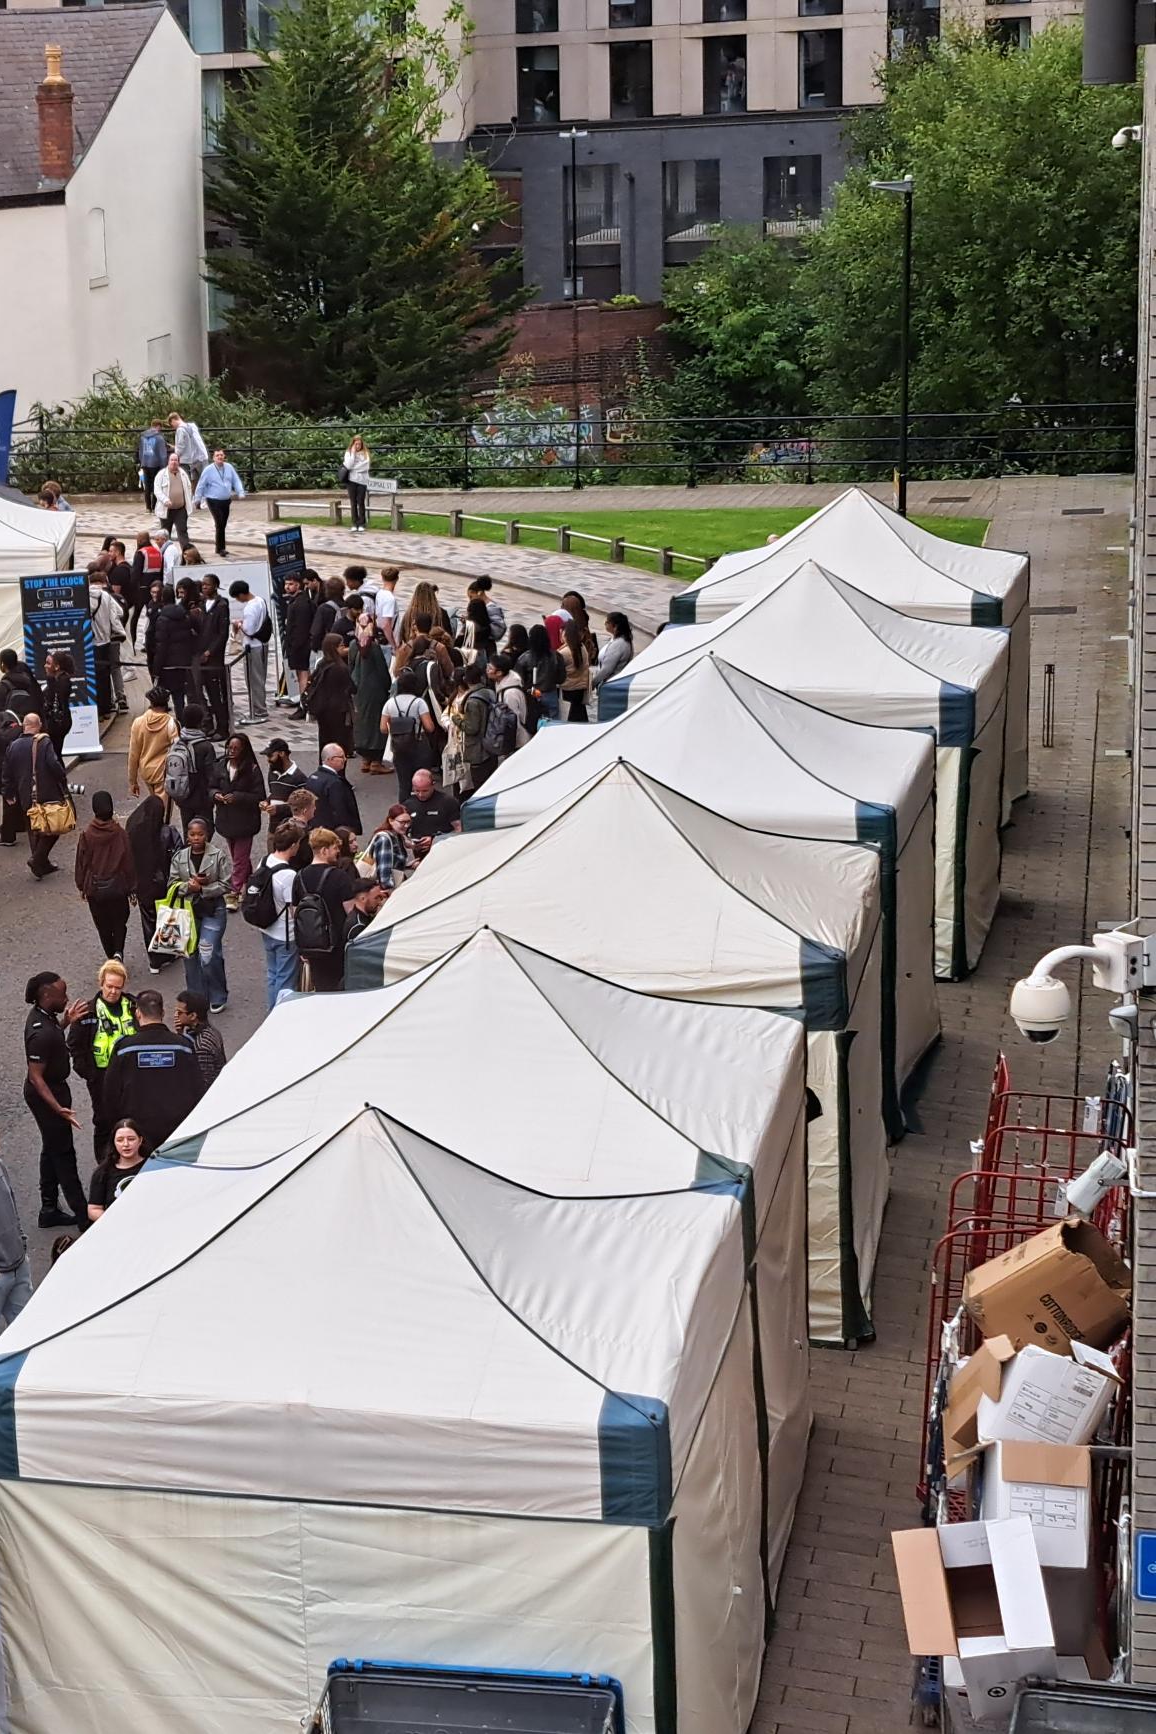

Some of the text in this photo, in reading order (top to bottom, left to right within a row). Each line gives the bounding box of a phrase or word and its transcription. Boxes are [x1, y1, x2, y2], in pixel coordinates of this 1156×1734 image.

[24, 575, 84, 589] STOP THE CLOCK
